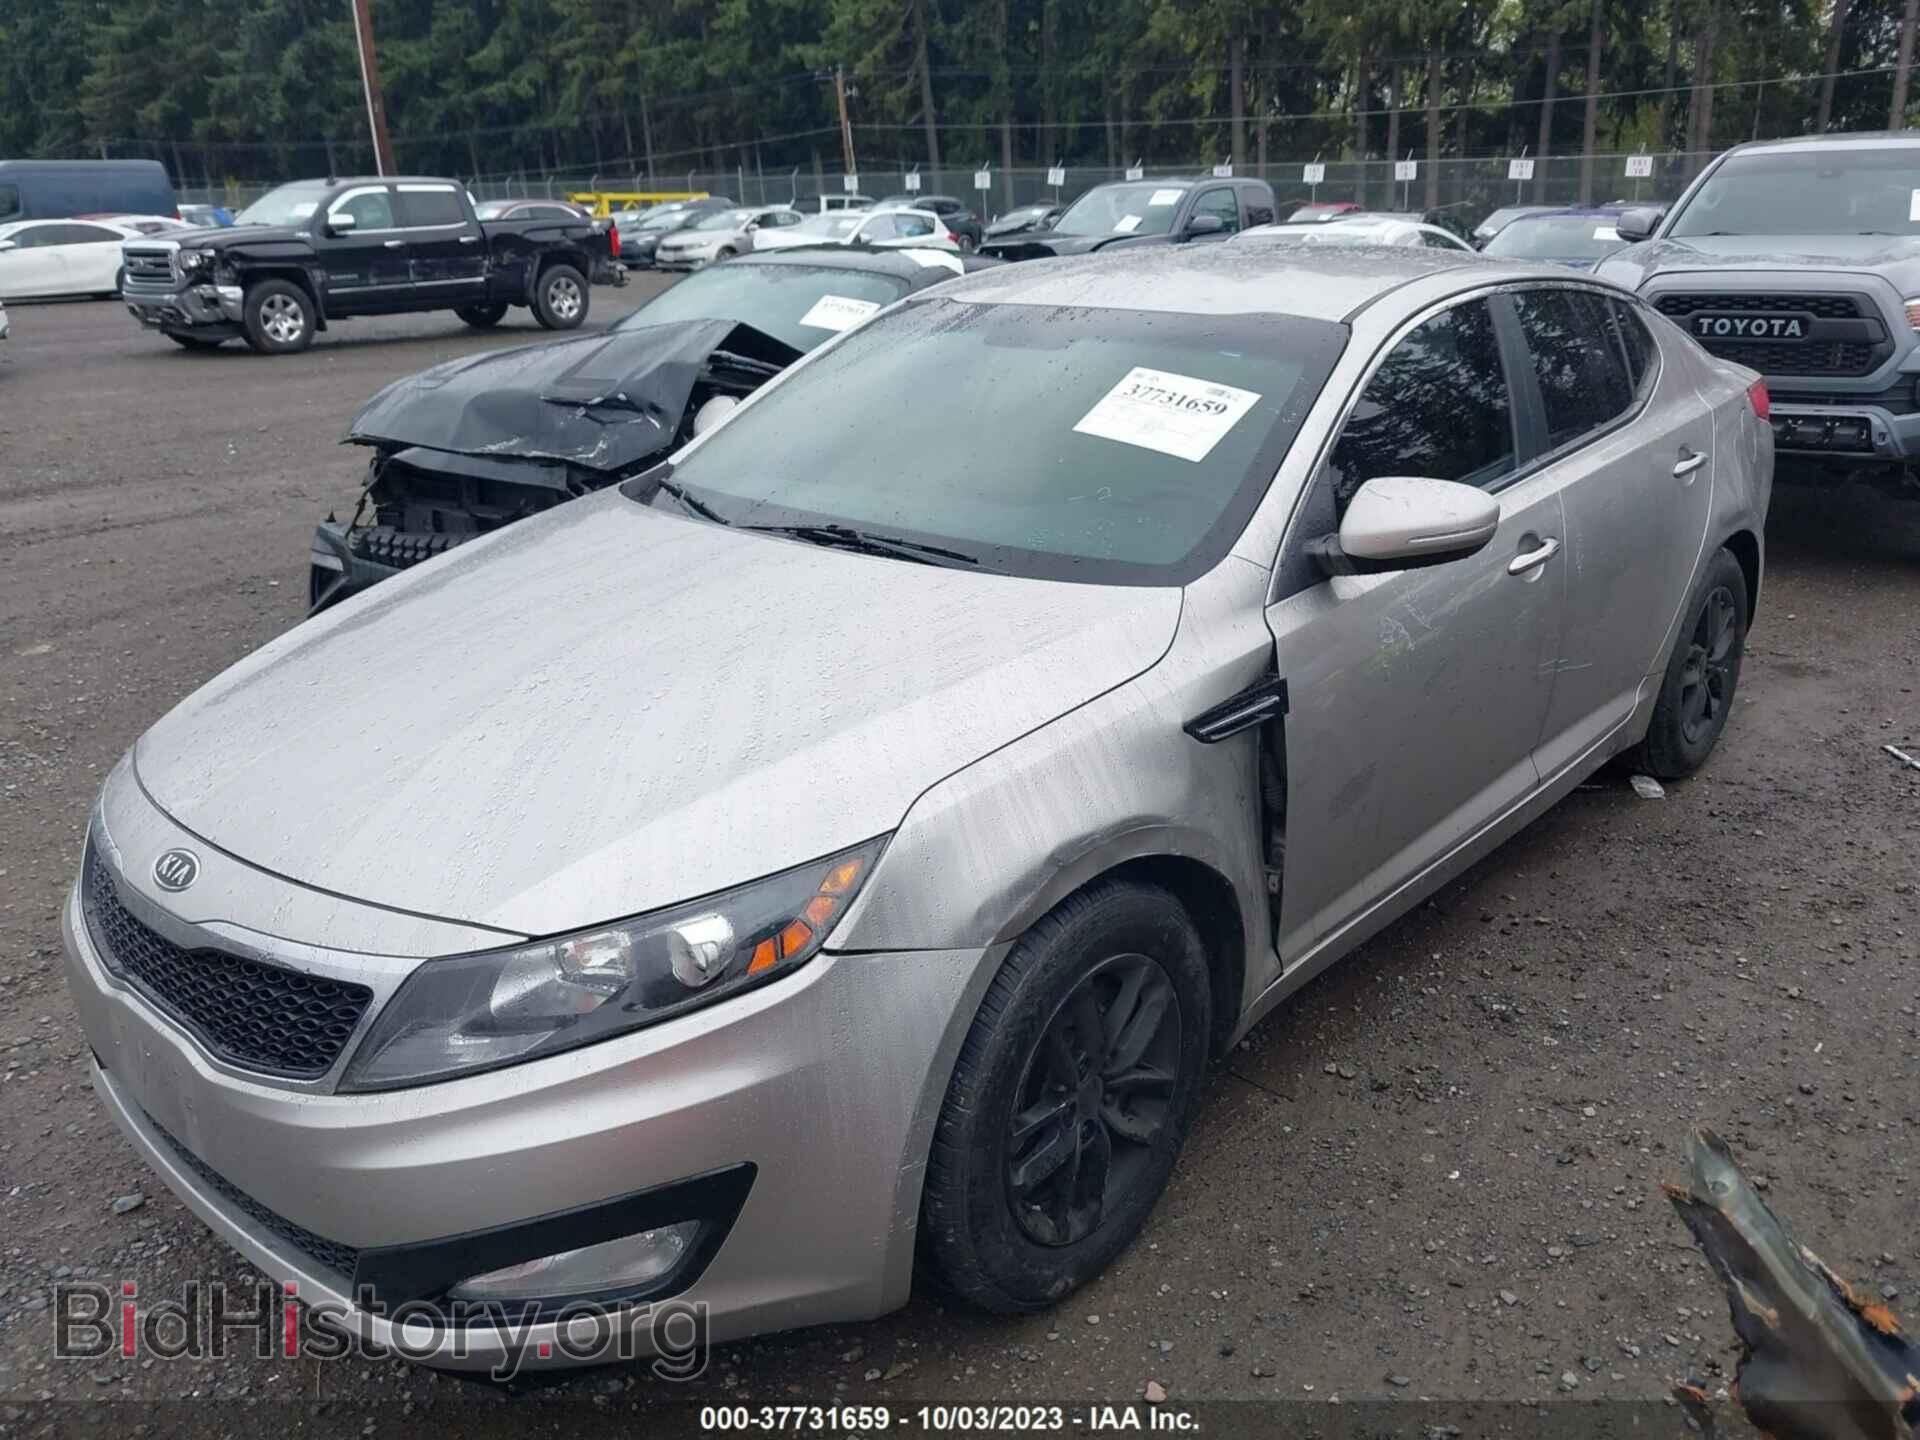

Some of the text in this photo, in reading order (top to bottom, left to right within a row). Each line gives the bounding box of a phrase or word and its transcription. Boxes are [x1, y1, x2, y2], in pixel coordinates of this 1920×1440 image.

[1698, 318, 1802, 337] TOYOTA
[1123, 383, 1229, 416] 37731659
[158, 854, 192, 886] KIA
